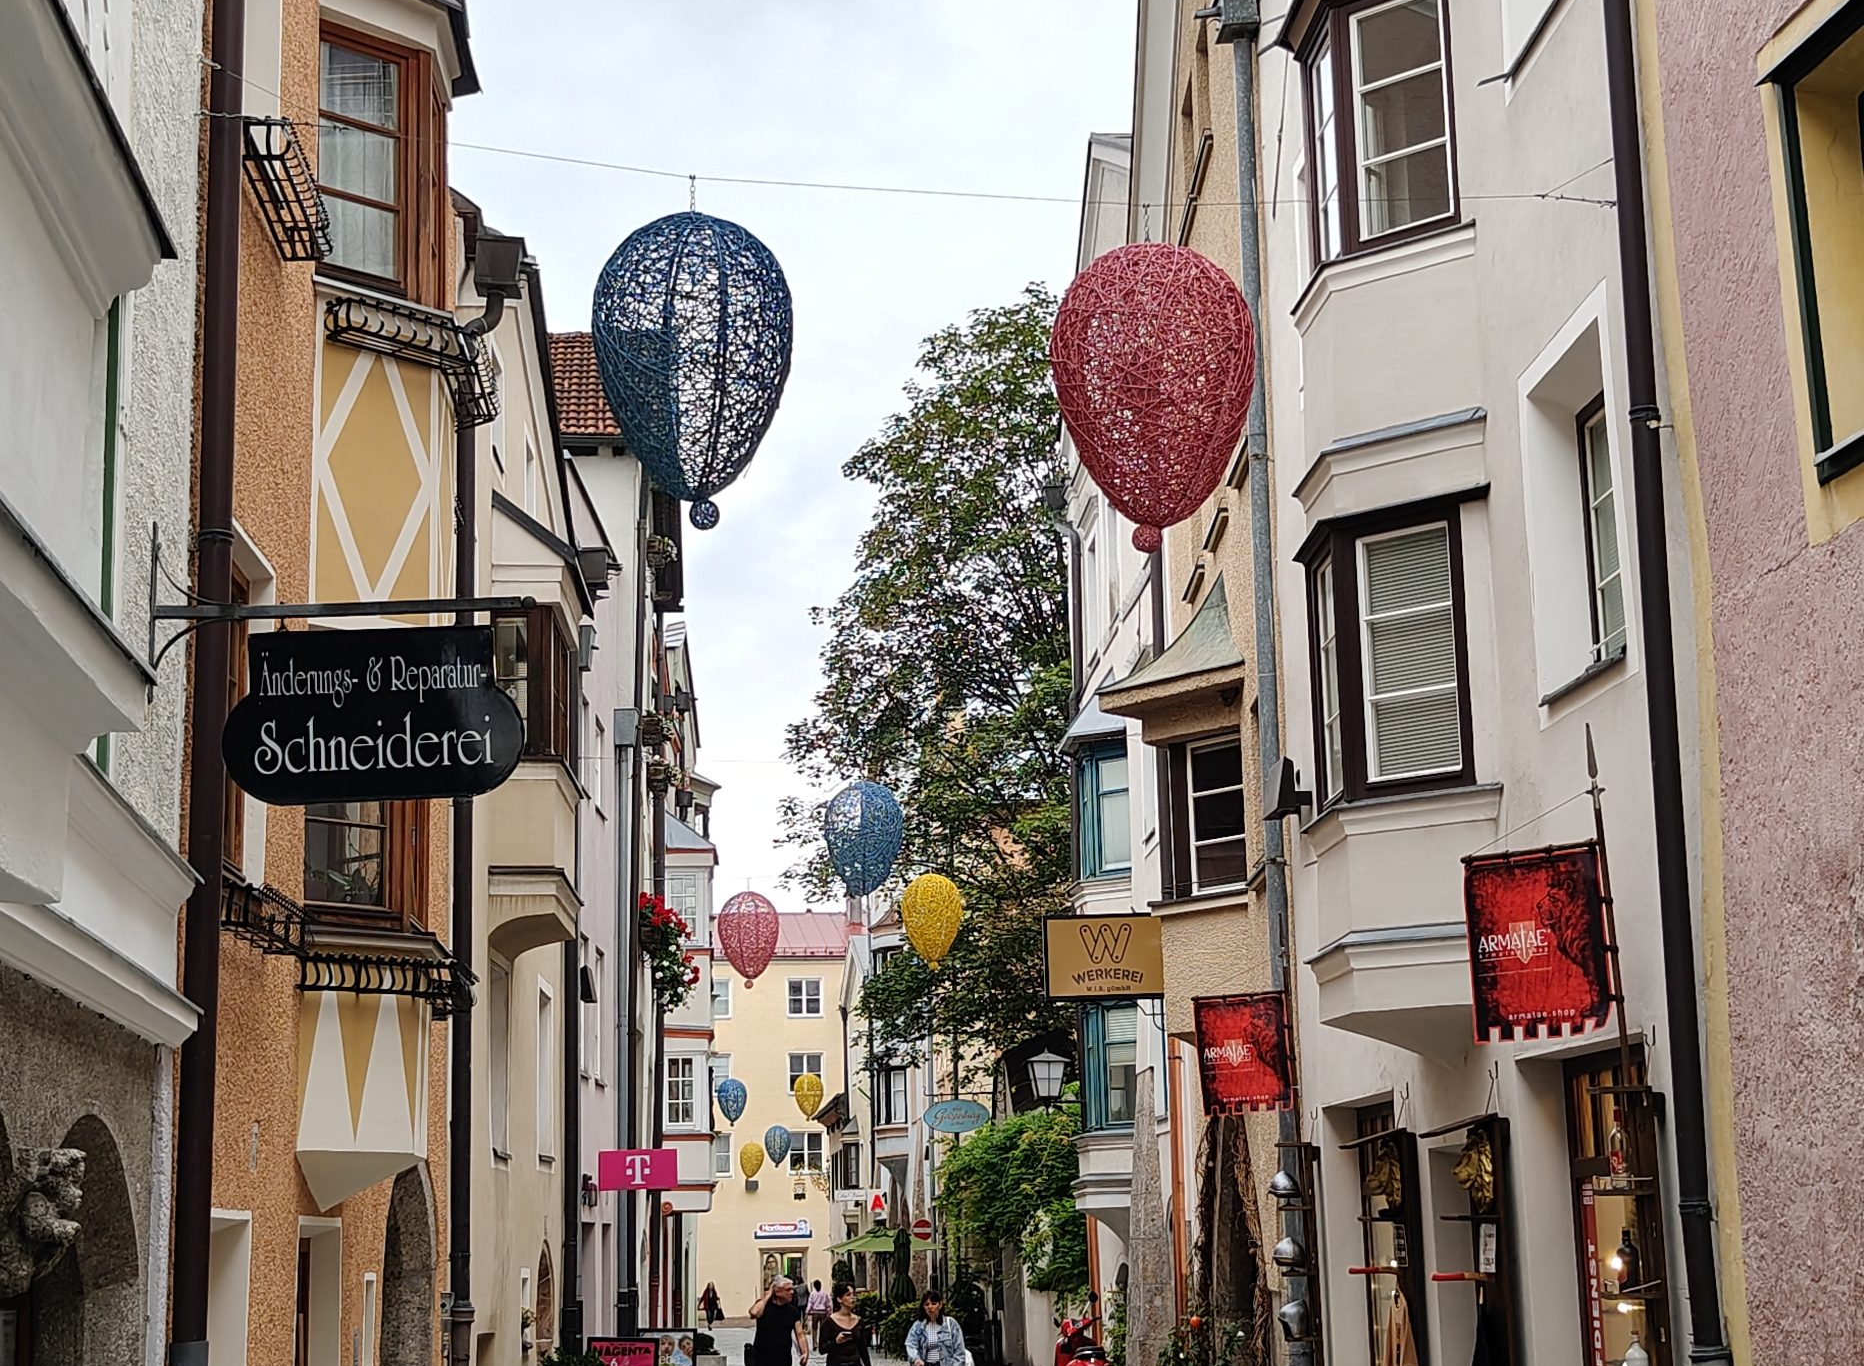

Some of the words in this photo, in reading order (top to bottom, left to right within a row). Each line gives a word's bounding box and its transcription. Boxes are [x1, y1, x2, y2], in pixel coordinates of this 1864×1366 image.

[259, 651, 358, 708] Änderungs-
[366, 656, 383, 693] &
[390, 655, 487, 703] Reparatur-
[254, 711, 494, 775] Schneiderei
[1071, 967, 1144, 985] WERKEREI
[625, 1155, 650, 1185] T
[592, 1345, 652, 1356] MAGENTA
